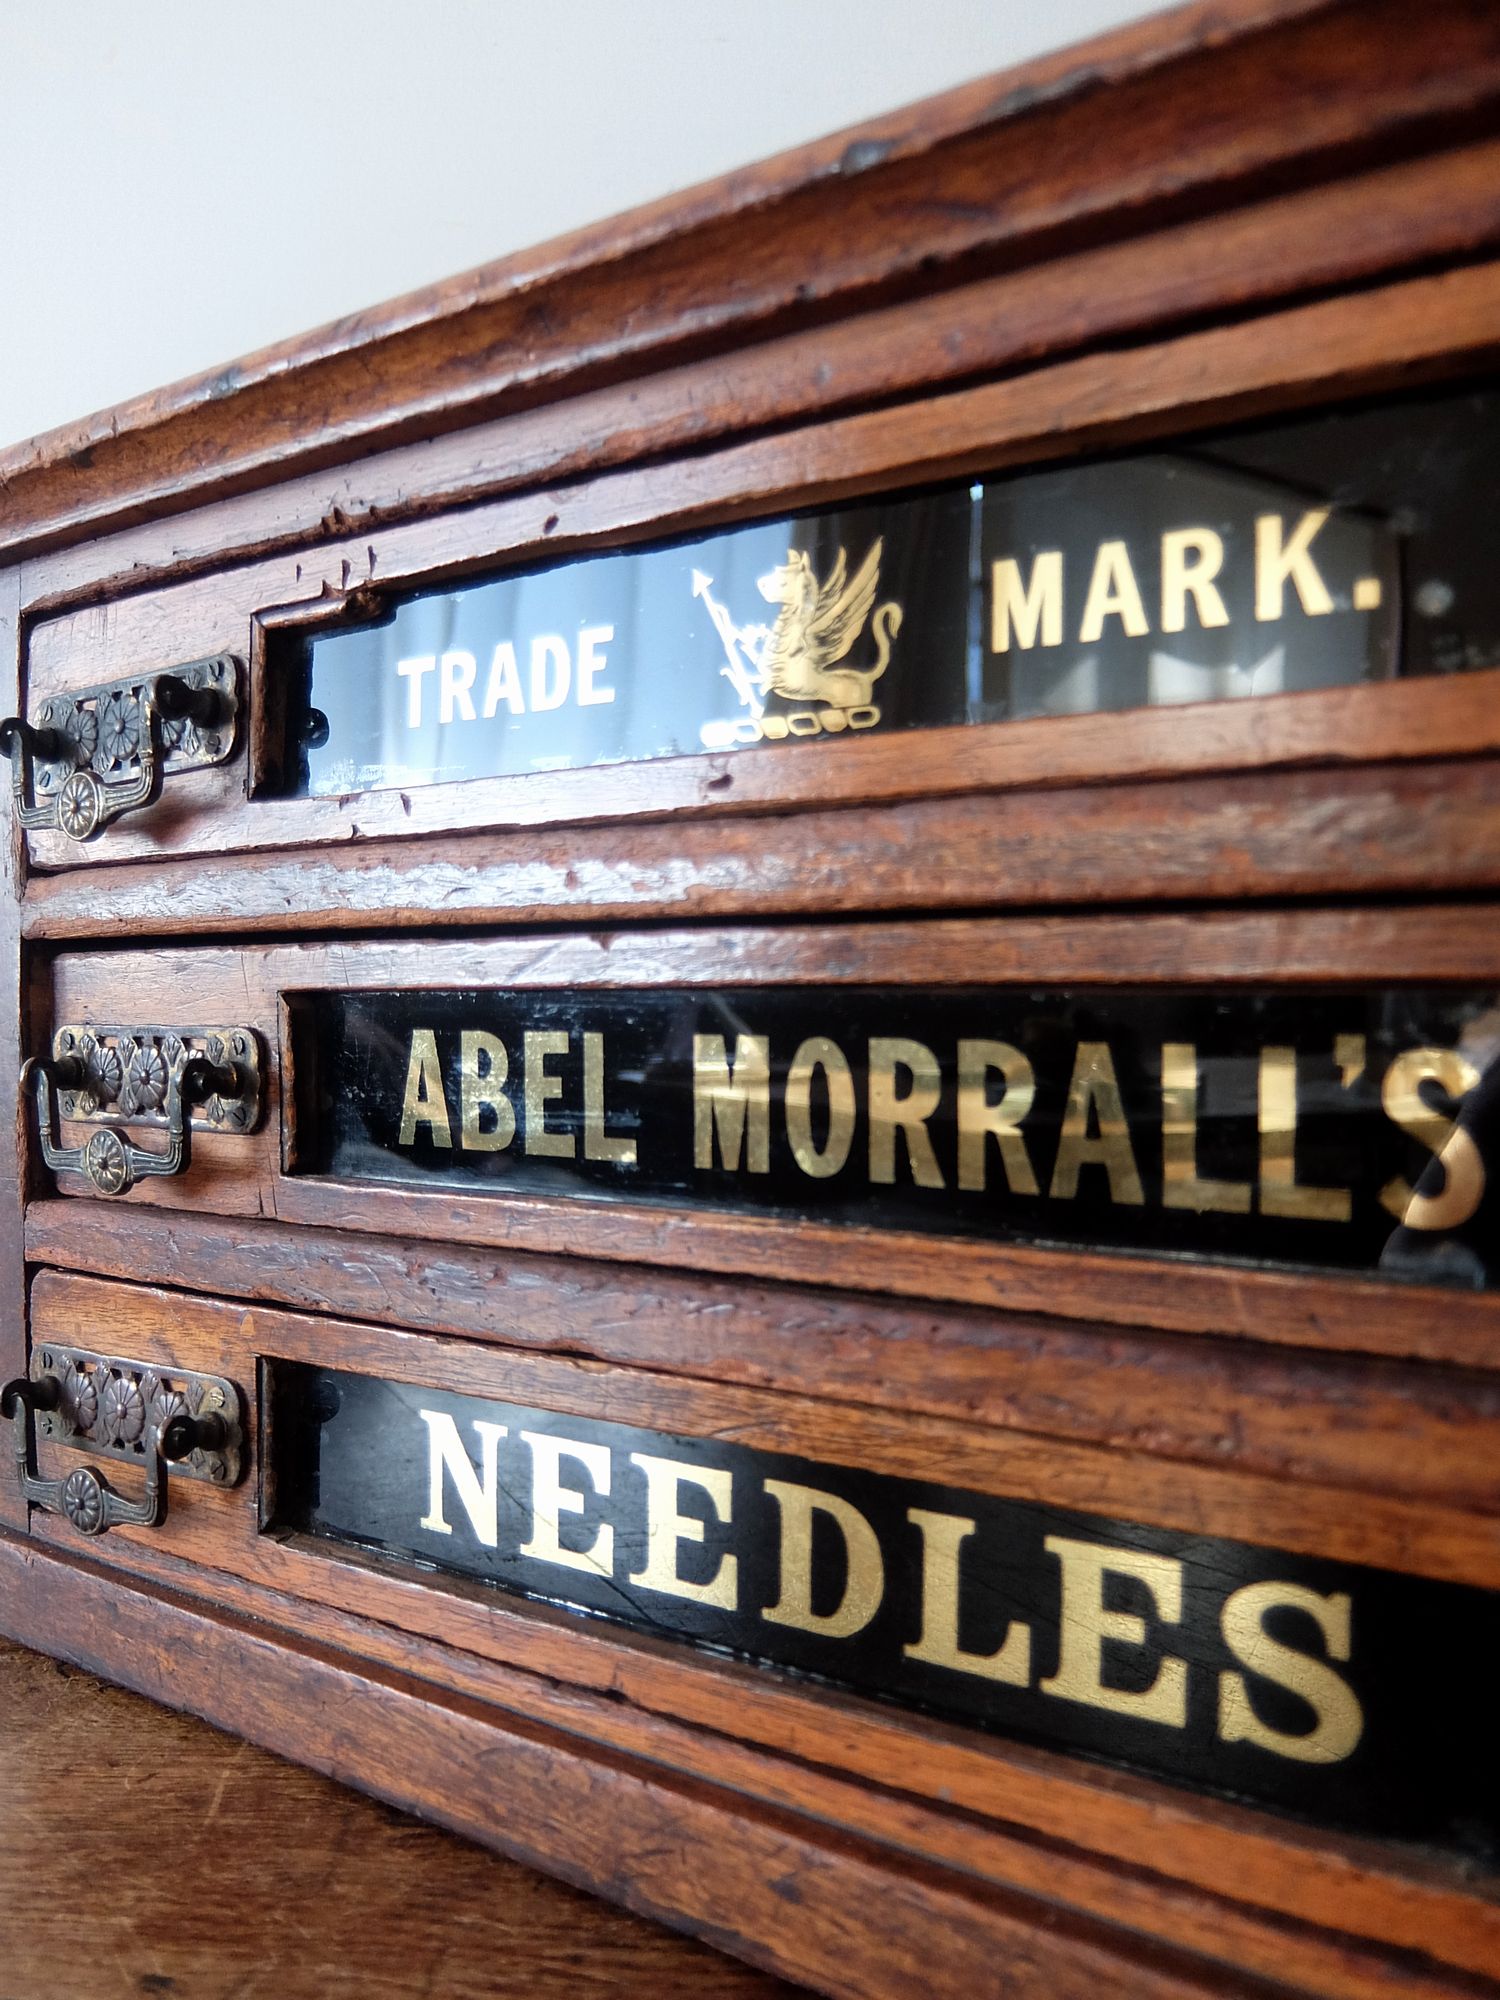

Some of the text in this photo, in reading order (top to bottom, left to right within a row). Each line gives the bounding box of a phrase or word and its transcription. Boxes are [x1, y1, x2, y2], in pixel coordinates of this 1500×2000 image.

[397, 506, 1382, 729] TRADE MARK.
[398, 1028, 1487, 1231] ABEL MORRALL'S
[418, 1407, 1365, 1765] NEEDLES
